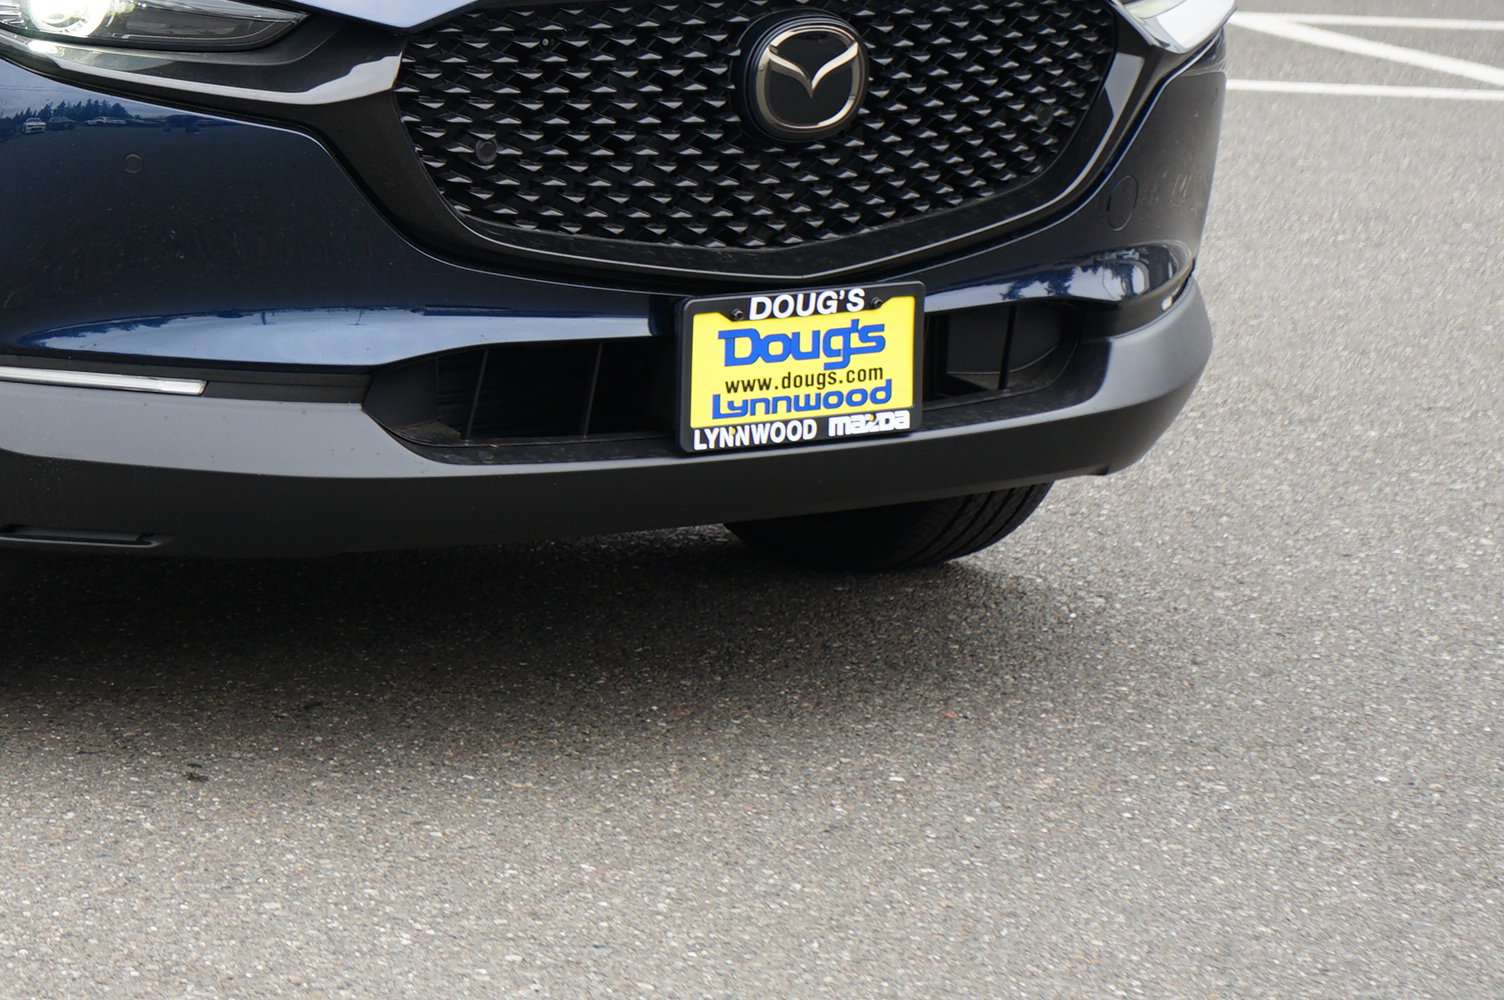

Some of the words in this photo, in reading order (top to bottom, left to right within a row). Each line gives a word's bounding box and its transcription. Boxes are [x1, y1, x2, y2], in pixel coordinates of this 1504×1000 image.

[748, 287, 866, 321] DOUG'S
[717, 318, 886, 371] Doug's
[725, 366, 884, 394] www.dougs.com
[712, 378, 893, 420] Lynnwood
[693, 418, 818, 451] LYNNWOOD
